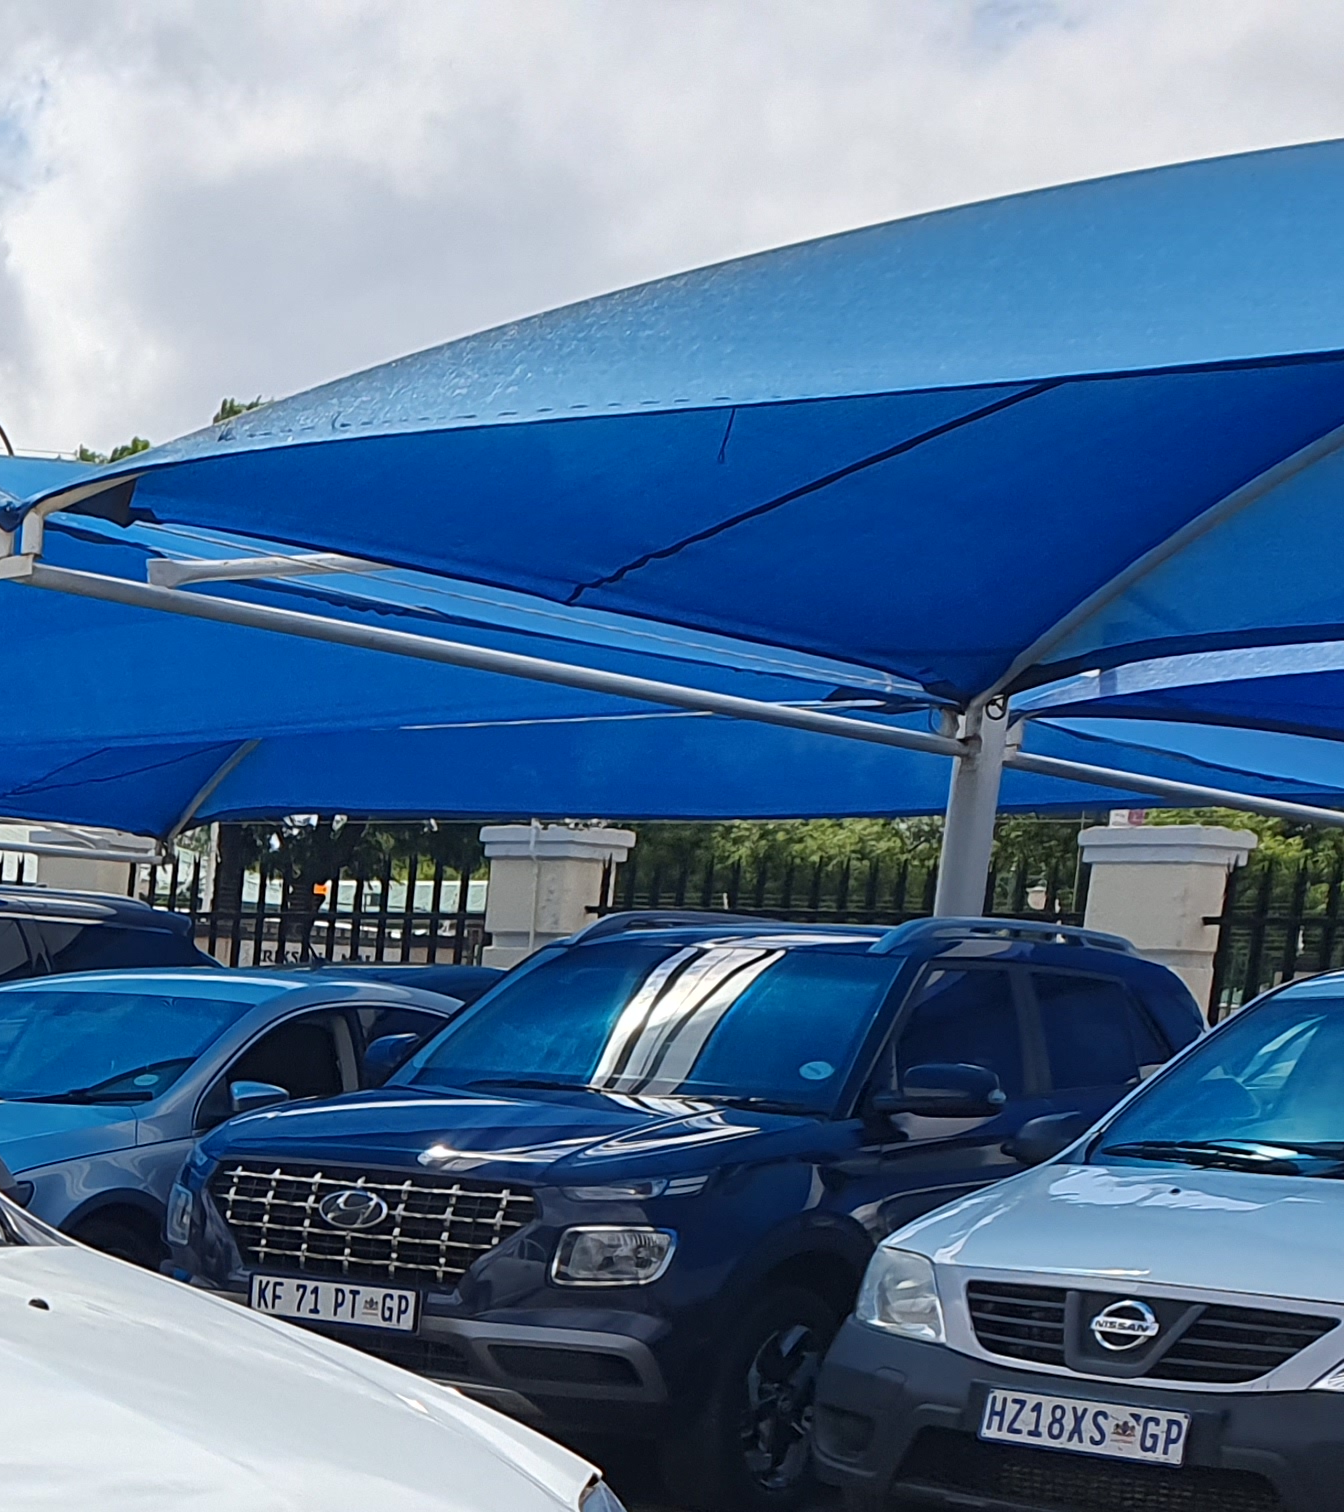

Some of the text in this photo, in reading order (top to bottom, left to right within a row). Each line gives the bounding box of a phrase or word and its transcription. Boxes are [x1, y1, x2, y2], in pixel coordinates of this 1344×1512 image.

[257, 1279, 409, 1325] KF 71 PT GP
[1094, 1319, 1150, 1333] NISSAN
[985, 1394, 1183, 1456] HZ18XS GP
